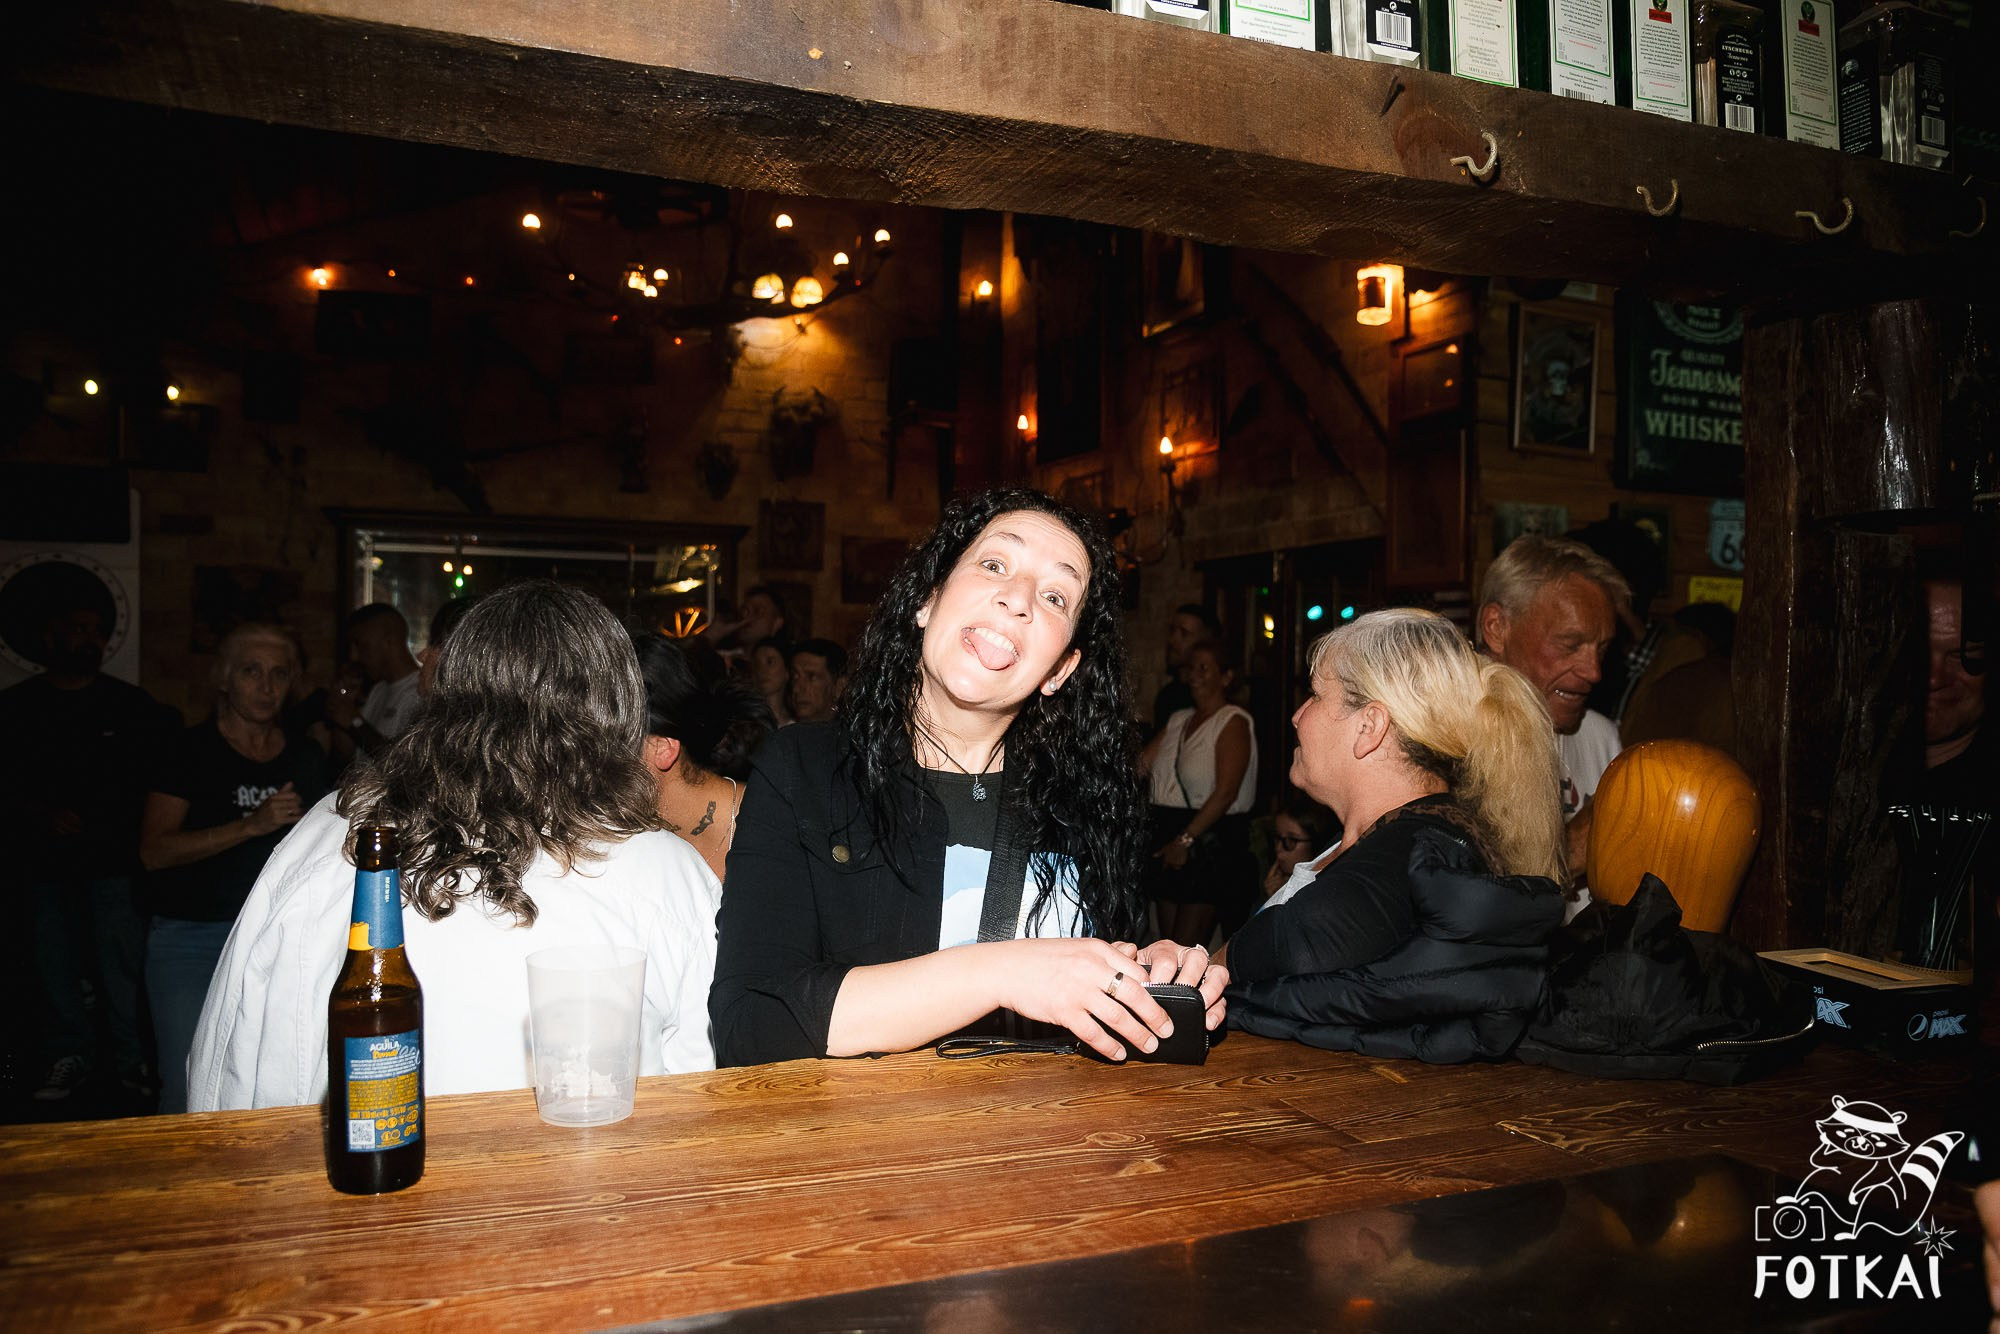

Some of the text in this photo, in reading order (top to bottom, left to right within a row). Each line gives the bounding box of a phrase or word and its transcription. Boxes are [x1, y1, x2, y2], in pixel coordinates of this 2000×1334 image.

[1649, 348, 1742, 397] Tennesse
[1645, 408, 1743, 446] WHISKE
[1816, 997, 1851, 1028] AX
[1927, 1014, 1968, 1039] MAX
